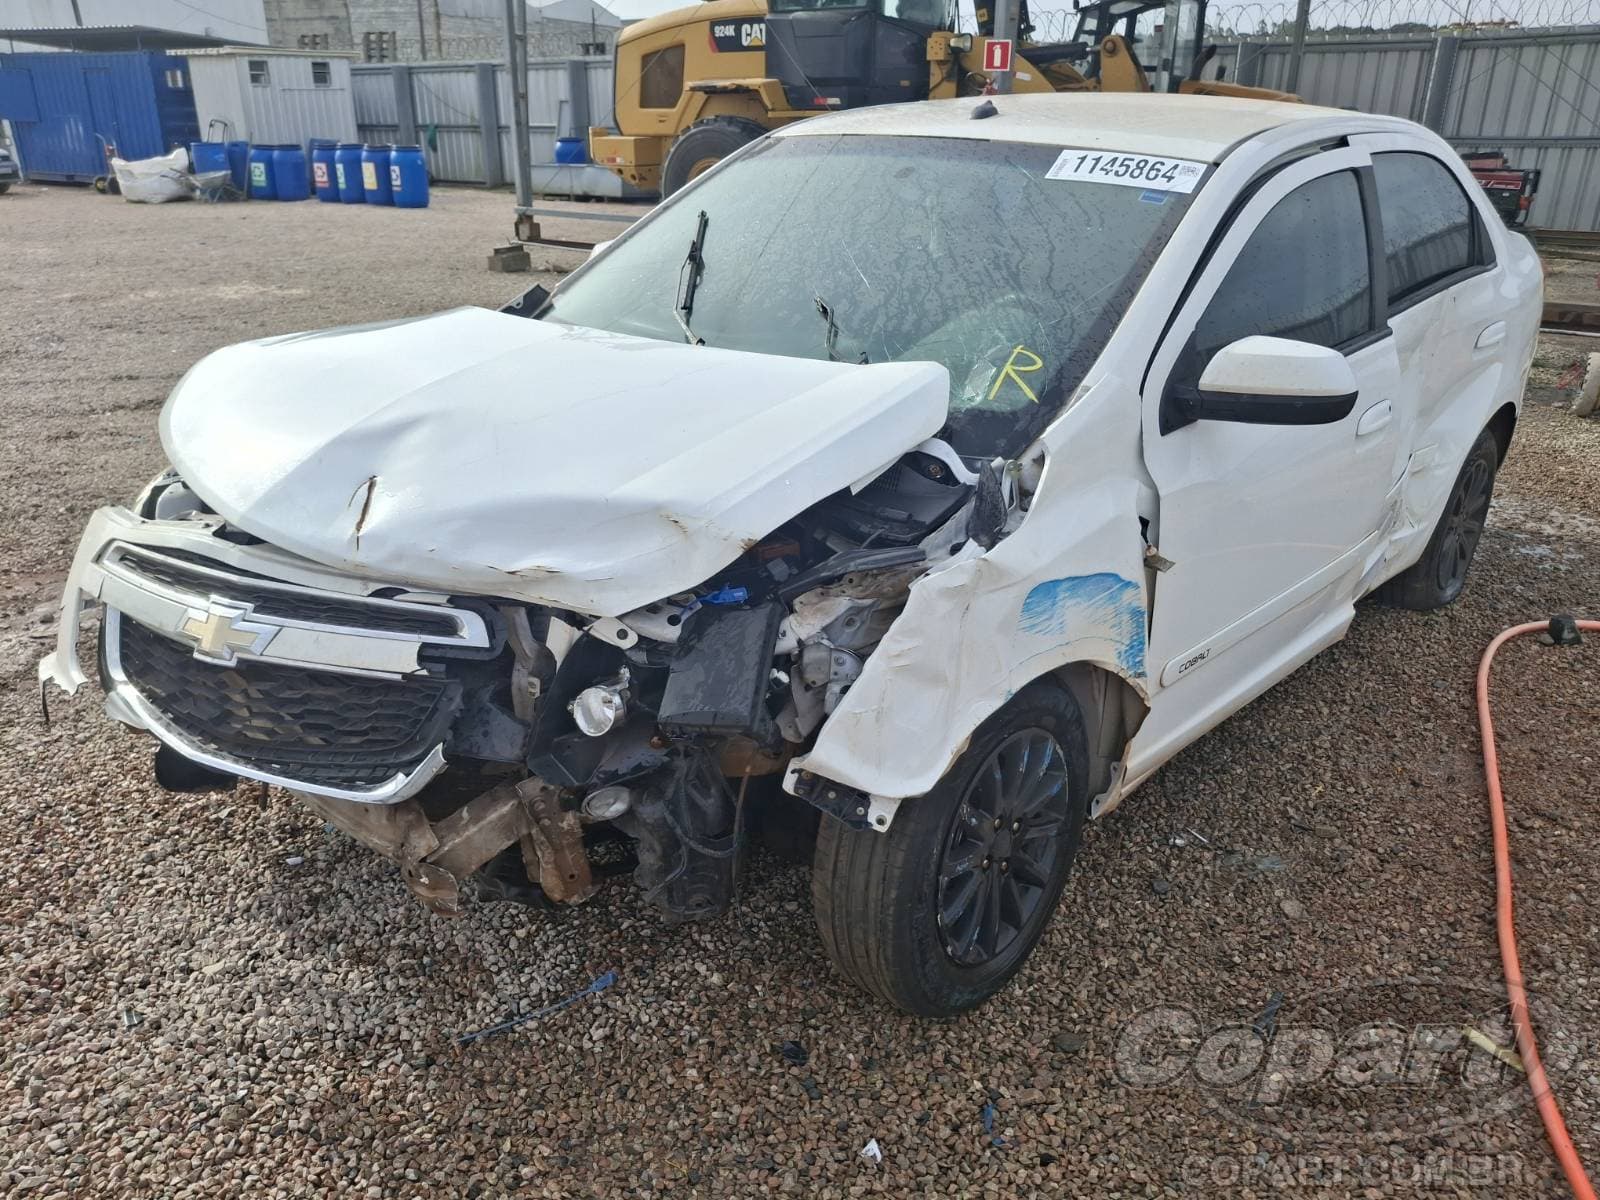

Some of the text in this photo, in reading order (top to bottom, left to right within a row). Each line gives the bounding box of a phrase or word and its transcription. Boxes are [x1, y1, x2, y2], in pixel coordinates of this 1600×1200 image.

[714, 25, 735, 37] 924K
[741, 23, 766, 46] CAT
[1073, 154, 1180, 183] 1145864
[988, 345, 1043, 403] R
[1178, 648, 1211, 673] COBALT
